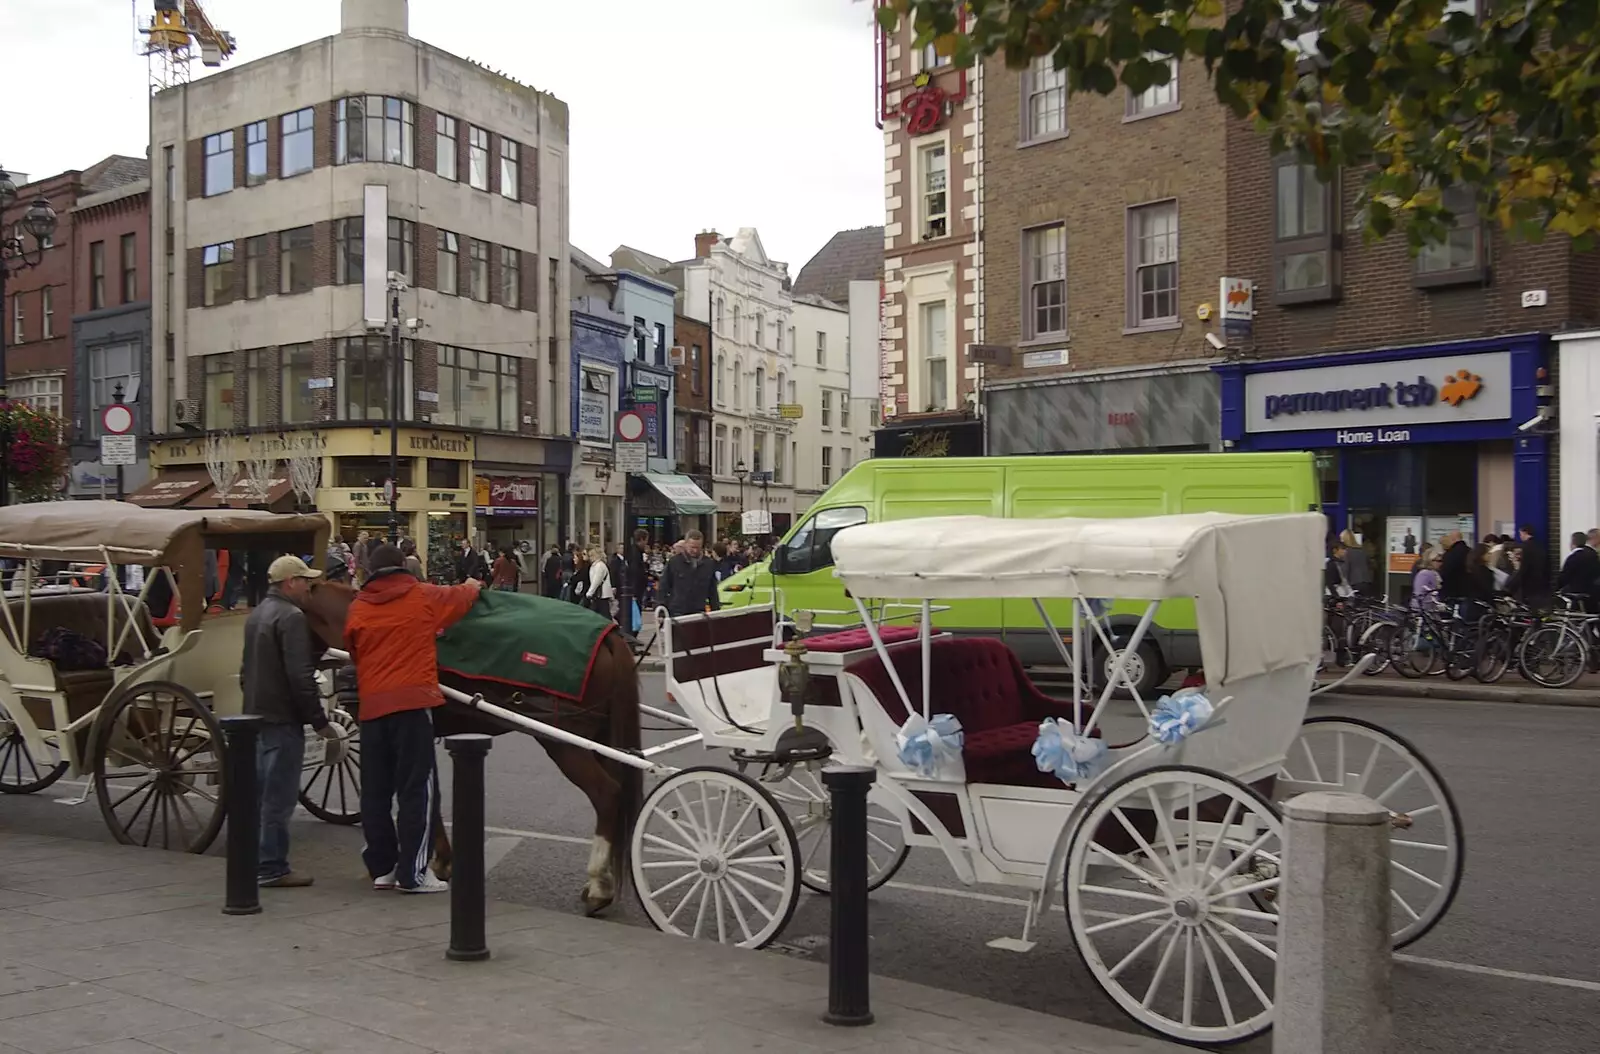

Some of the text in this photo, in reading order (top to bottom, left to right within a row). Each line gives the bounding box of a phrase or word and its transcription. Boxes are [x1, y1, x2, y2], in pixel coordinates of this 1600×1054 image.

[1265, 375, 1437, 420] permanent tsb
[1336, 429, 1410, 444] Home Loan
